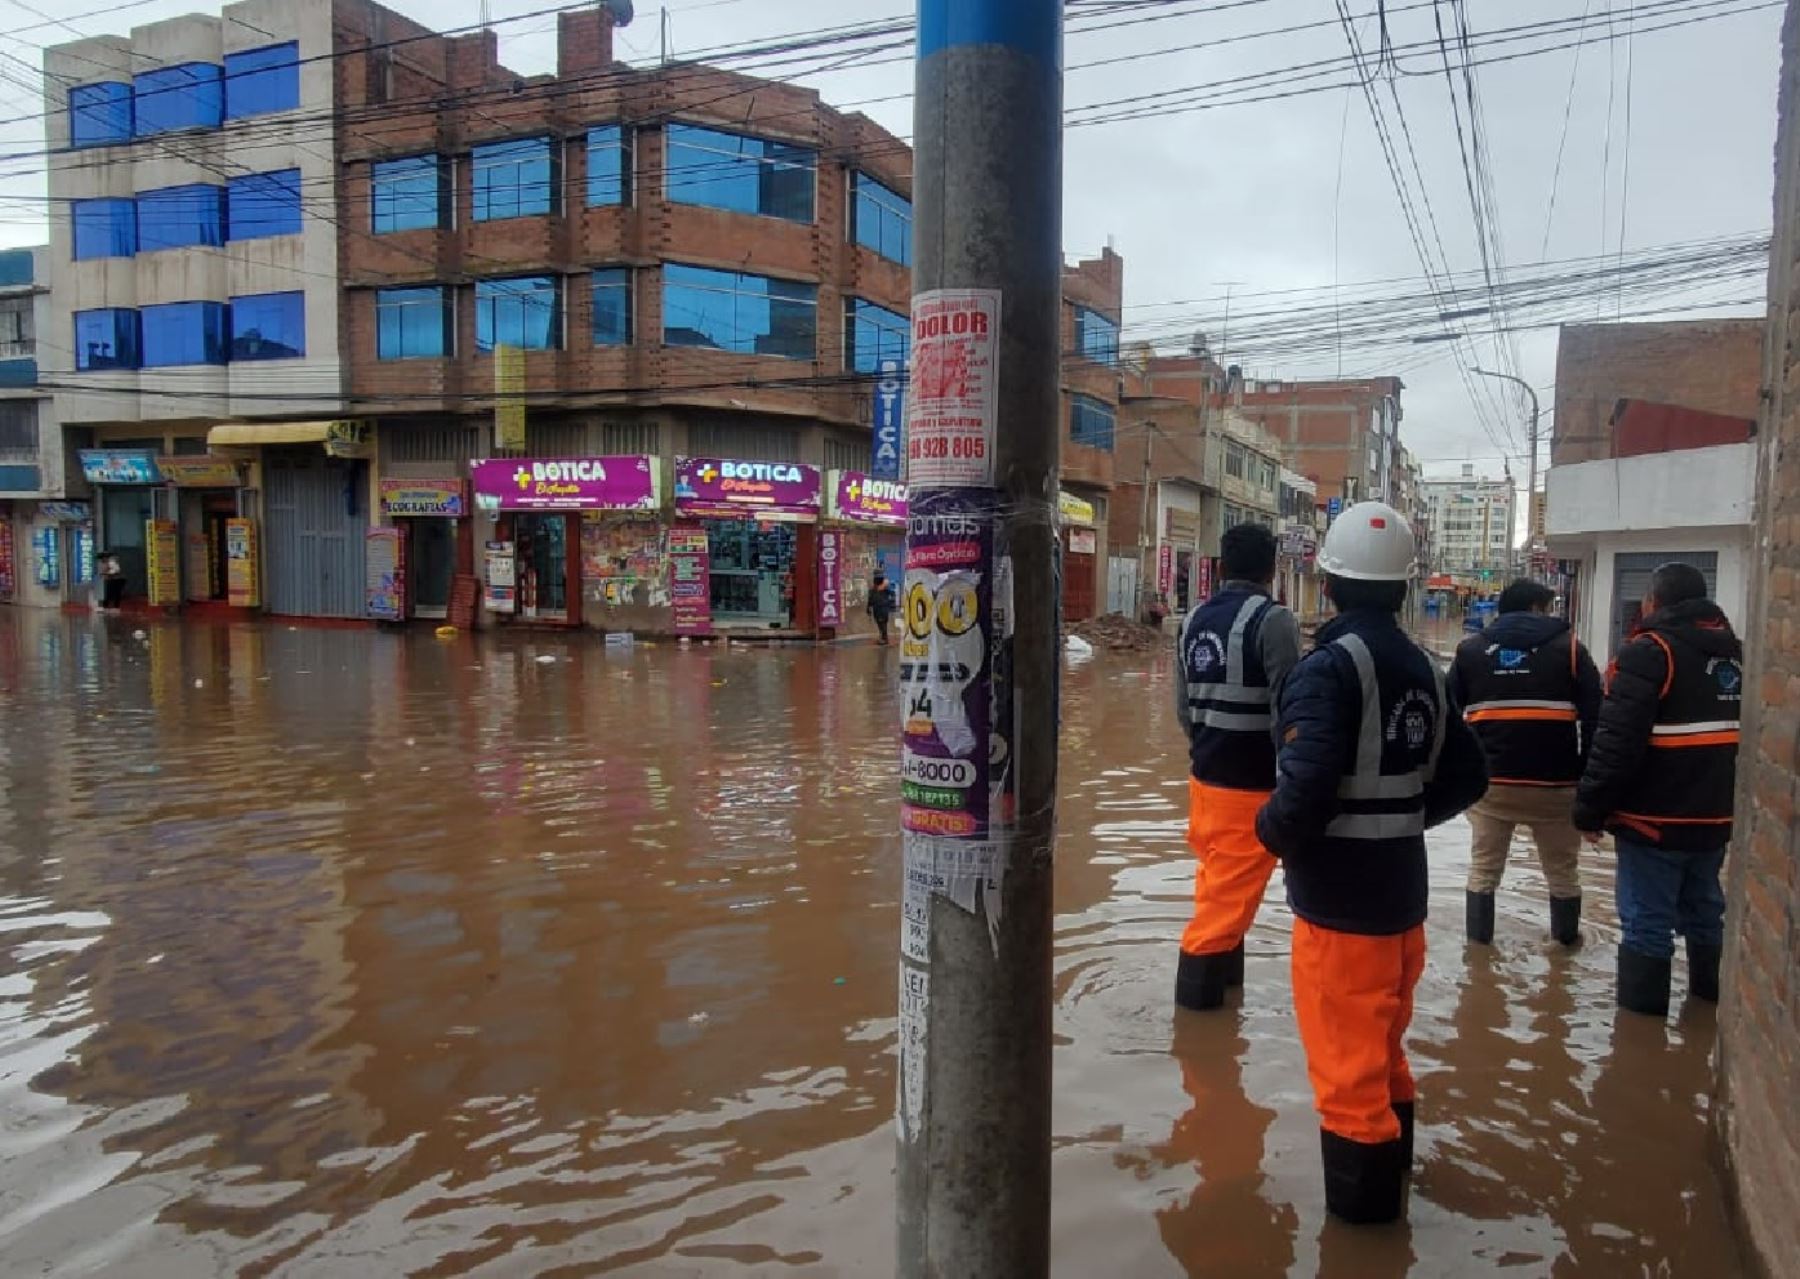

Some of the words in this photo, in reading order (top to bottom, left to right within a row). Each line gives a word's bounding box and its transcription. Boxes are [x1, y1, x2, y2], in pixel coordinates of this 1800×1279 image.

[917, 311, 988, 340] DOLOR
[877, 361, 898, 459] BOTICA
[953, 436, 984, 458] 805
[532, 460, 607, 482] BOTICA
[721, 462, 803, 483] BOTICA
[822, 533, 838, 618] BOTICA
